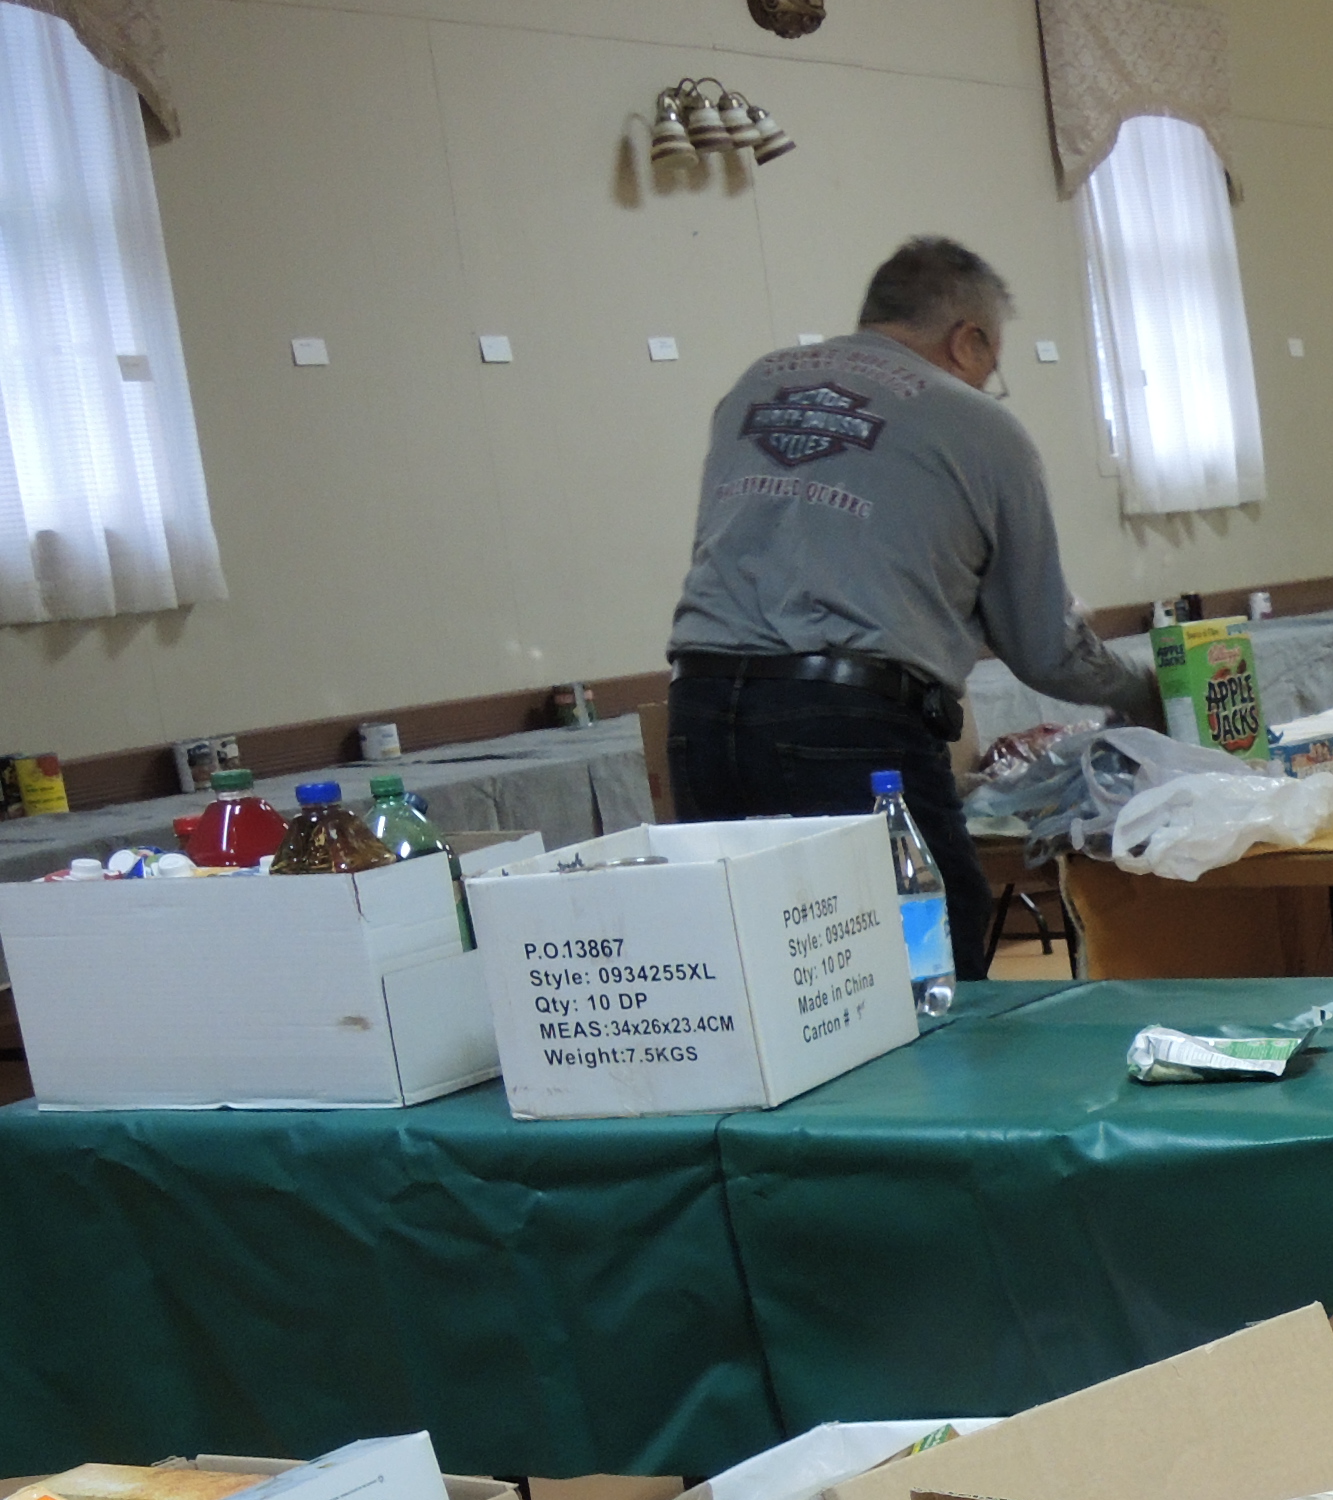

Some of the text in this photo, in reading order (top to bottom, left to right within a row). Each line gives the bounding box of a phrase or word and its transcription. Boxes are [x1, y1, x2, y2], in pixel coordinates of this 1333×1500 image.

[1205, 674, 1255, 712] APPLE
[1211, 705, 1260, 742] JACKS
[524, 938, 624, 960] P.O.13867
[788, 909, 881, 958] Style: 0934255XL
[529, 963, 716, 990] Style: 0934255XL
[793, 949, 852, 986] Qty: 10 DP
[535, 992, 648, 1016] Qty: 10 DP
[798, 972, 875, 1016] Made in China
[802, 1014, 841, 1044] Carton
[544, 1046, 698, 1069] Weight:7.5KGS
